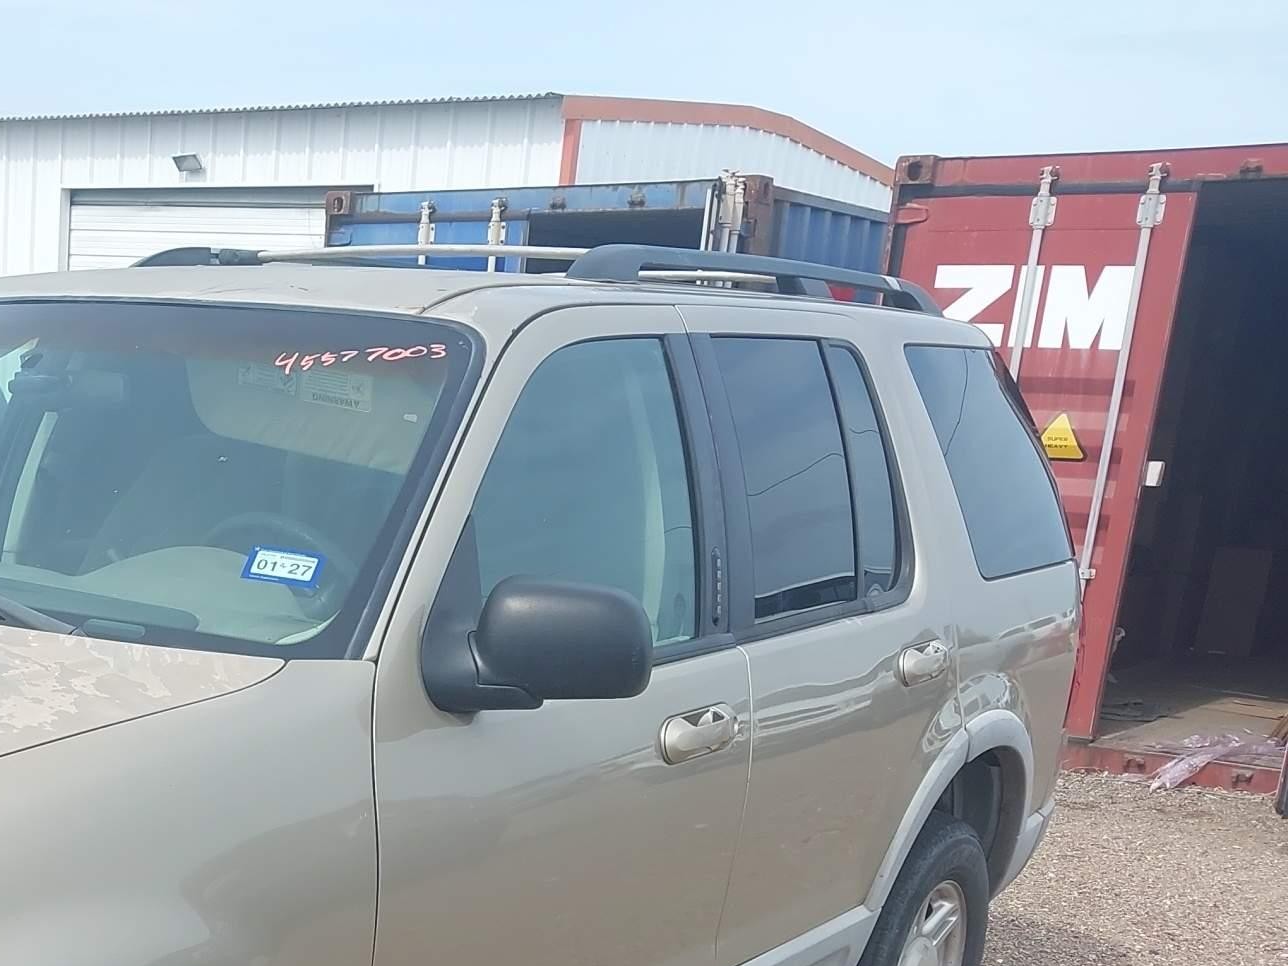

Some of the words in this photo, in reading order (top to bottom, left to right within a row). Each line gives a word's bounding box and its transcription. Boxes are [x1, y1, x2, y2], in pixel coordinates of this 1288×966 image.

[934, 264, 1137, 350] ZIM
[257, 559, 278, 572] 01
[288, 563, 312, 577] 27
